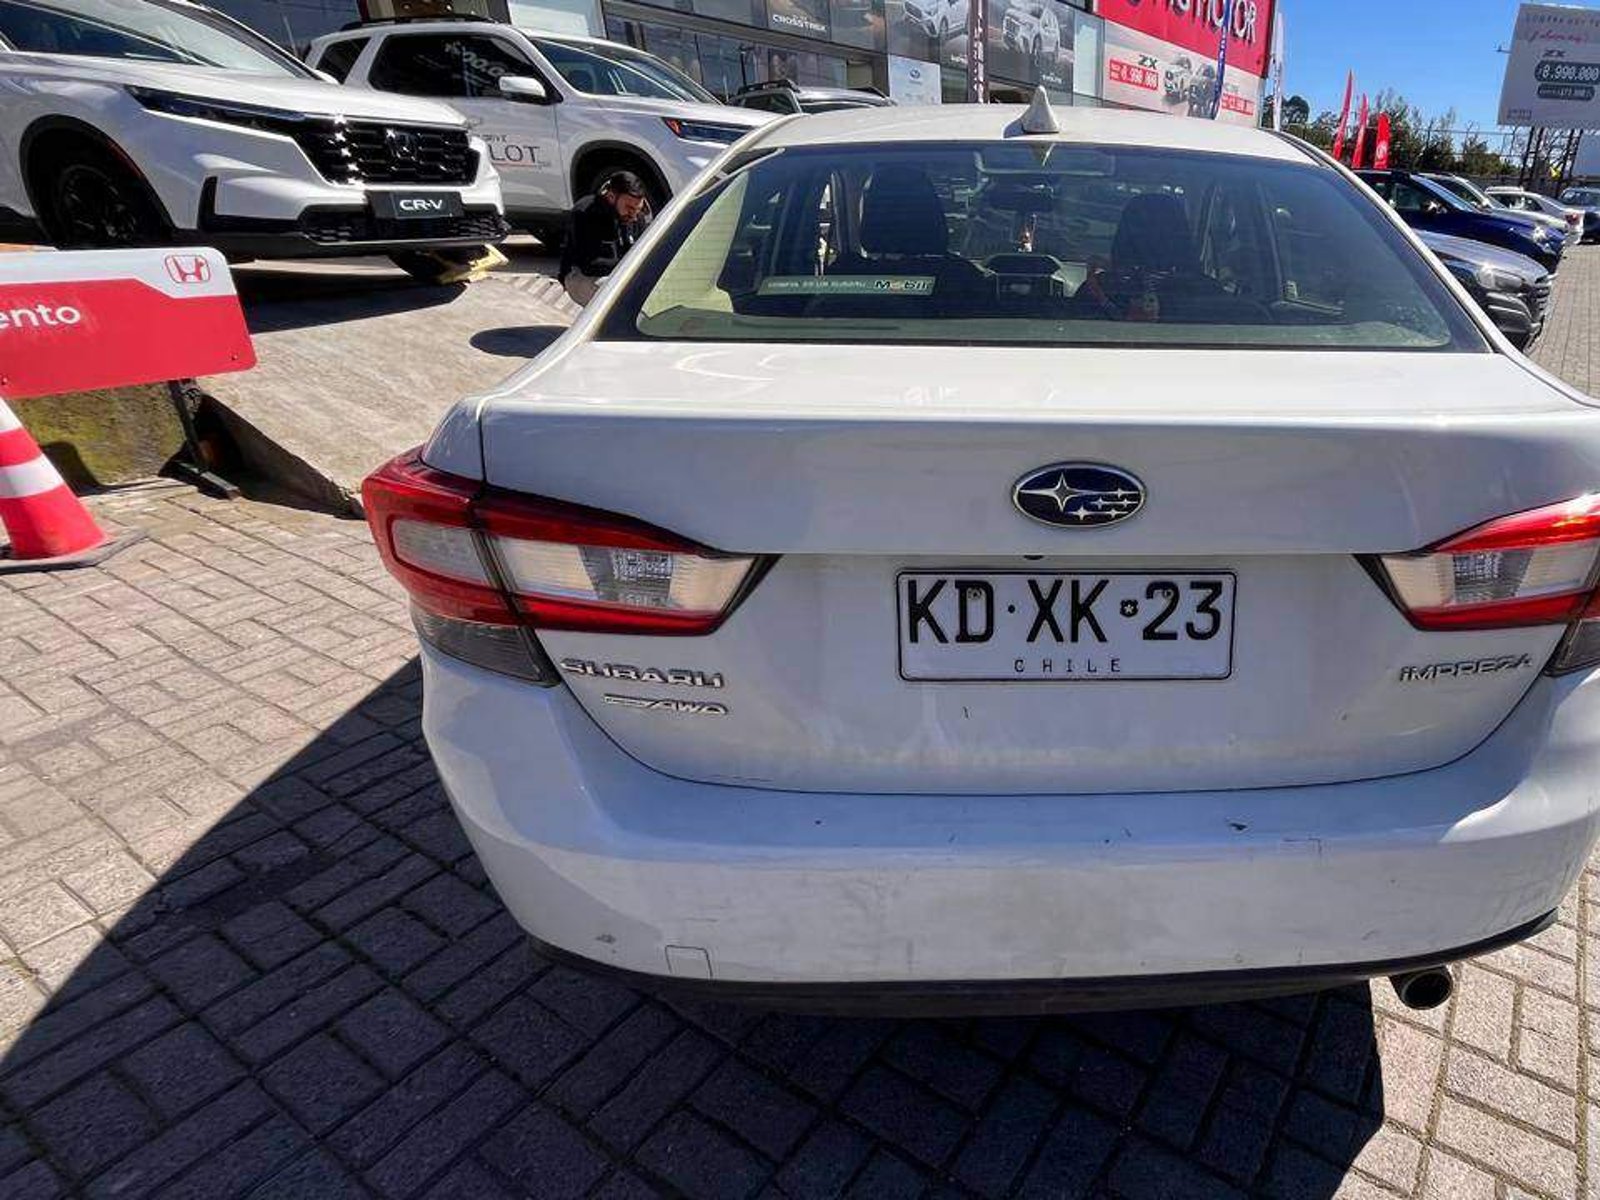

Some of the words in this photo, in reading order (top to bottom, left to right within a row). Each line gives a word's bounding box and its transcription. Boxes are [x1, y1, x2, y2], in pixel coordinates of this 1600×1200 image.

[1138, 54, 1159, 70] ZX
[487, 144, 541, 163] LOT
[400, 199, 443, 211] CR-V
[907, 579, 995, 643] KD
[1026, 579, 1110, 643] XK
[1142, 580, 1223, 642] 23
[559, 657, 725, 689] SUBARU
[1014, 659, 1121, 673] CHILE
[1399, 653, 1533, 682] IMPREZA
[651, 699, 728, 715] AWD
